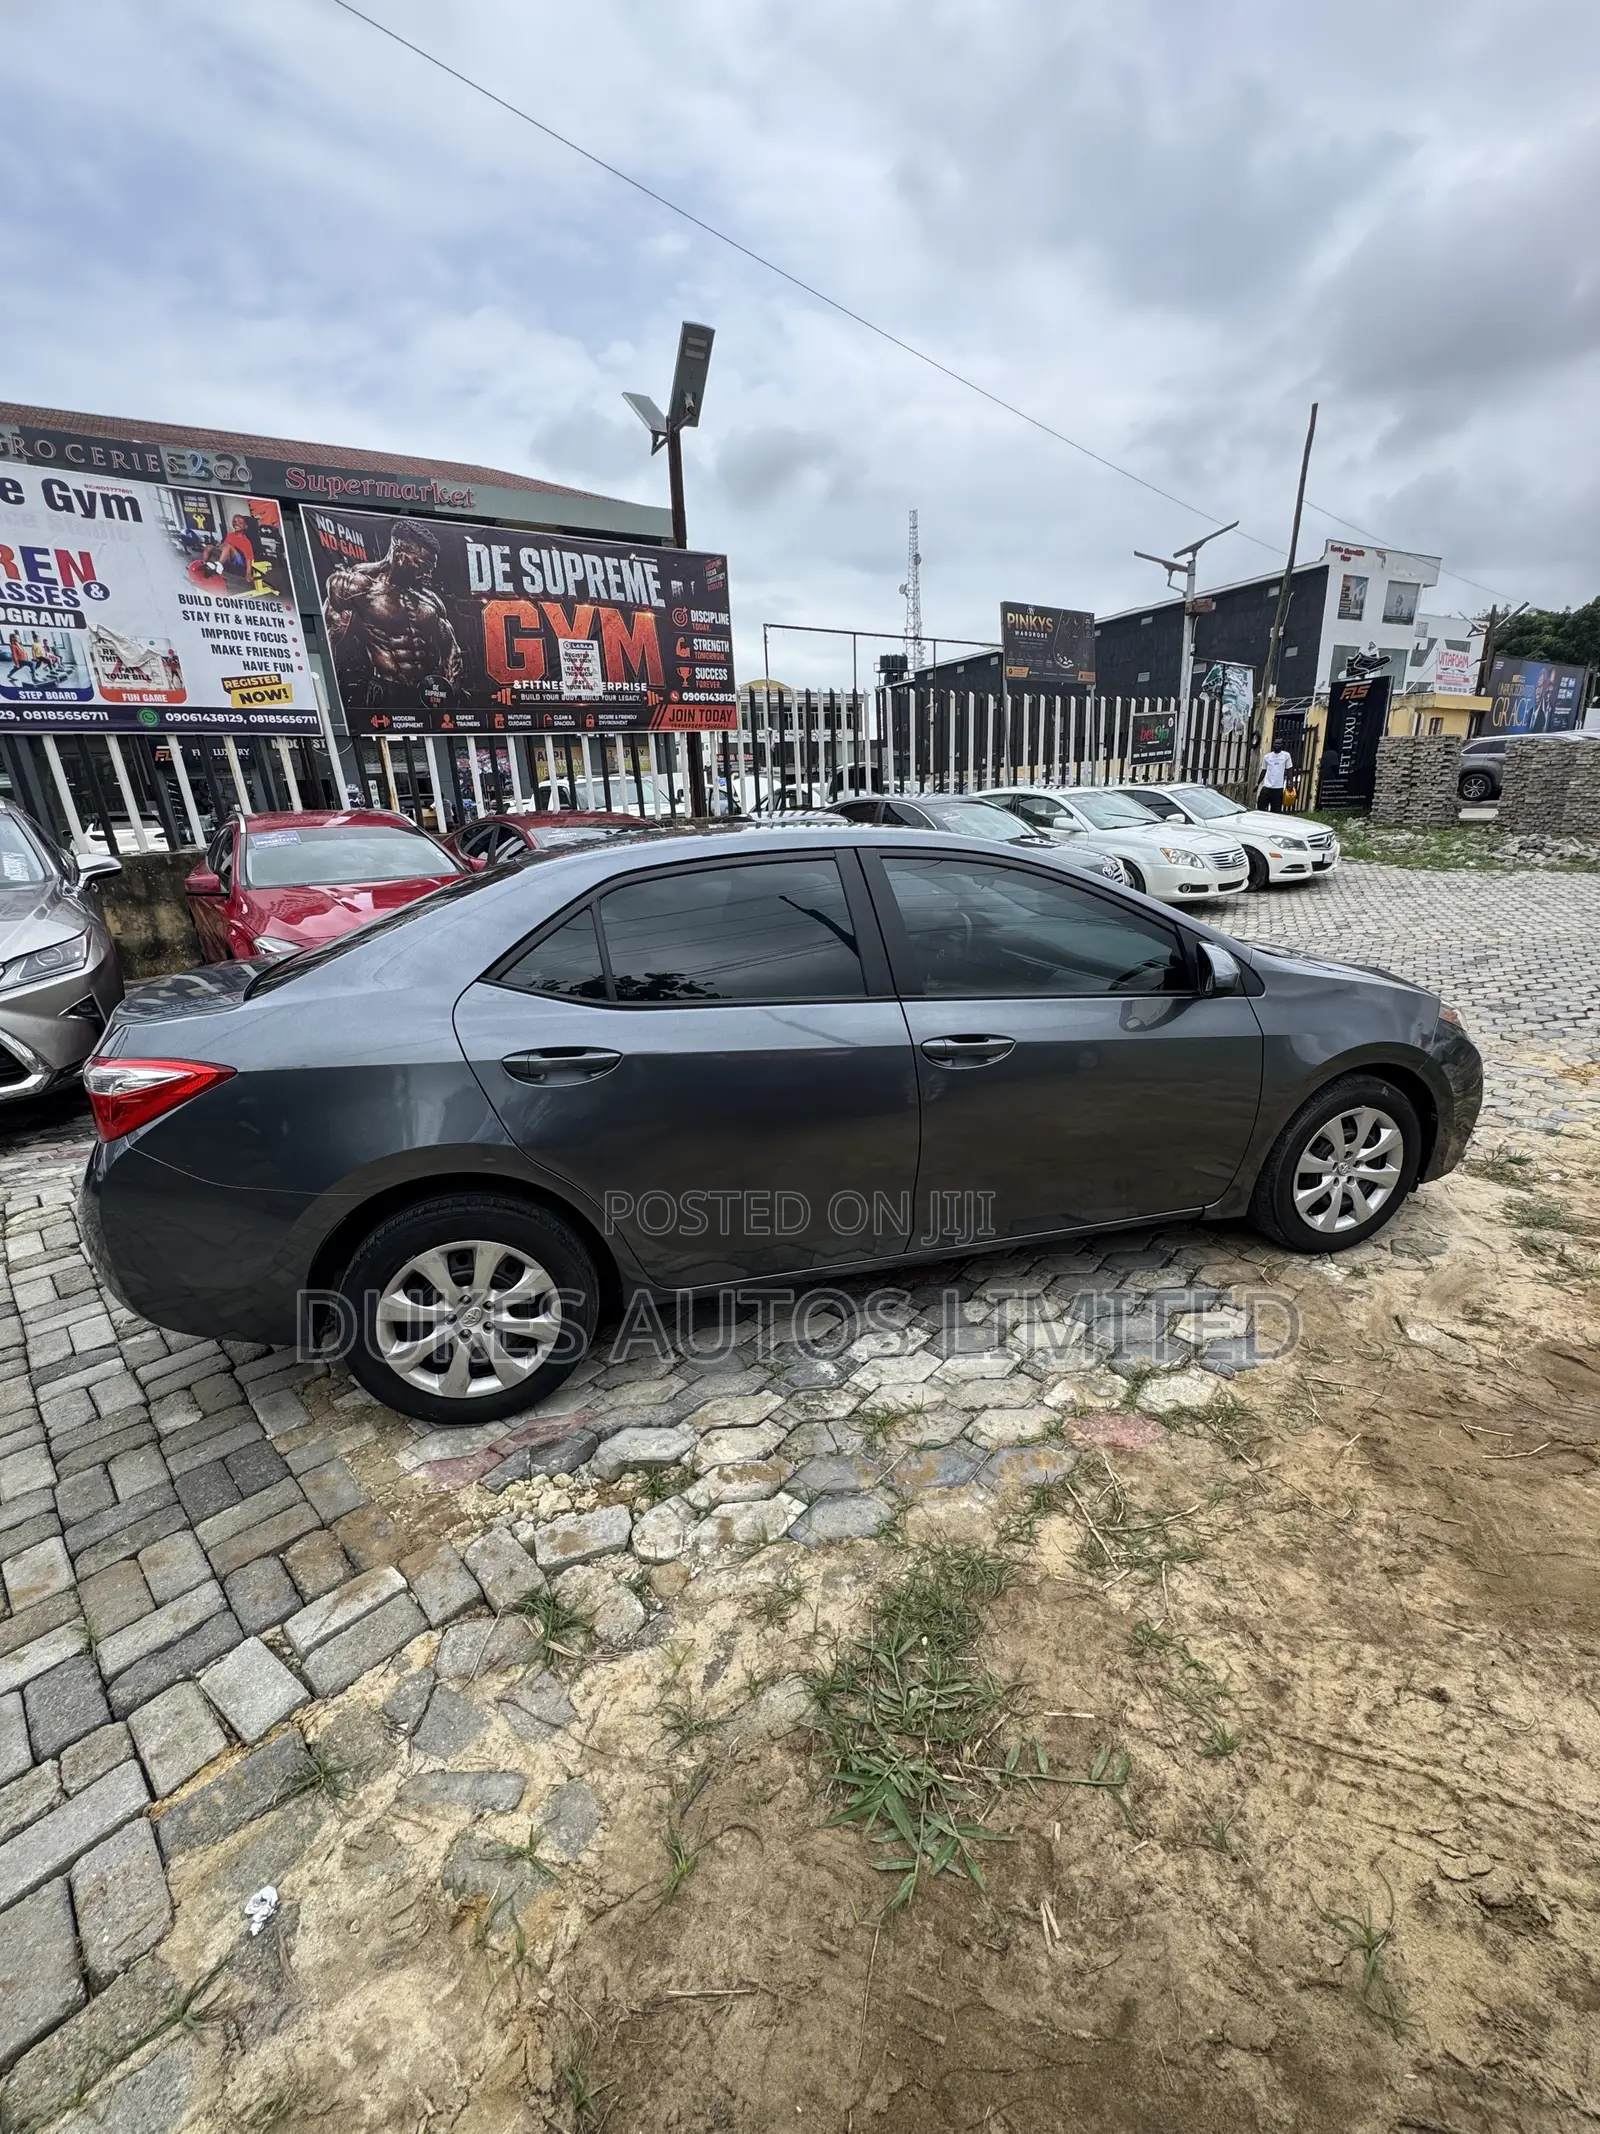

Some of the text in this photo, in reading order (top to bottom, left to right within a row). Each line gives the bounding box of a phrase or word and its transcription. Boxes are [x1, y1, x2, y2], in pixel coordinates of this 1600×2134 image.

[0, 433, 179, 474] ROCERIES
[285, 467, 476, 508] Supermarket
[41, 478, 143, 523] Gym
[315, 512, 365, 548] NO PAIN
[319, 532, 368, 562] NO GAIN
[466, 541, 666, 608] DE SUPREME
[178, 594, 284, 613] BUILD CONFIDENCE
[182, 610, 285, 628] STAY FIT & HEALTH
[690, 609, 730, 626] DISCIPLINE
[1007, 612, 1054, 632] PINKYS
[201, 628, 288, 644] IMPROVE FOCUS
[1014, 630, 1048, 639] WARDROBE
[211, 644, 291, 659] MAKE FRIENDS
[482, 599, 665, 689] GYM
[693, 638, 730, 653] STRENGTH
[242, 661, 294, 673] HAVE FUN
[695, 667, 728, 681] SUCCESS
[223, 675, 279, 689] REGISTER
[513, 679, 565, 691] &FITNES
[19, 691, 78, 701] STEP BOARD
[122, 692, 168, 703] FUN GAME
[238, 687, 289, 705] NOW!
[618, 694, 642, 702] LEGACY.
[25, 710, 109, 721] 08185656711
[669, 708, 732, 723] JOIN TODAY
[1492, 696, 1532, 727] GRACE
[213, 748, 250, 756] LUXRY
[1338, 753, 1351, 775] FET
